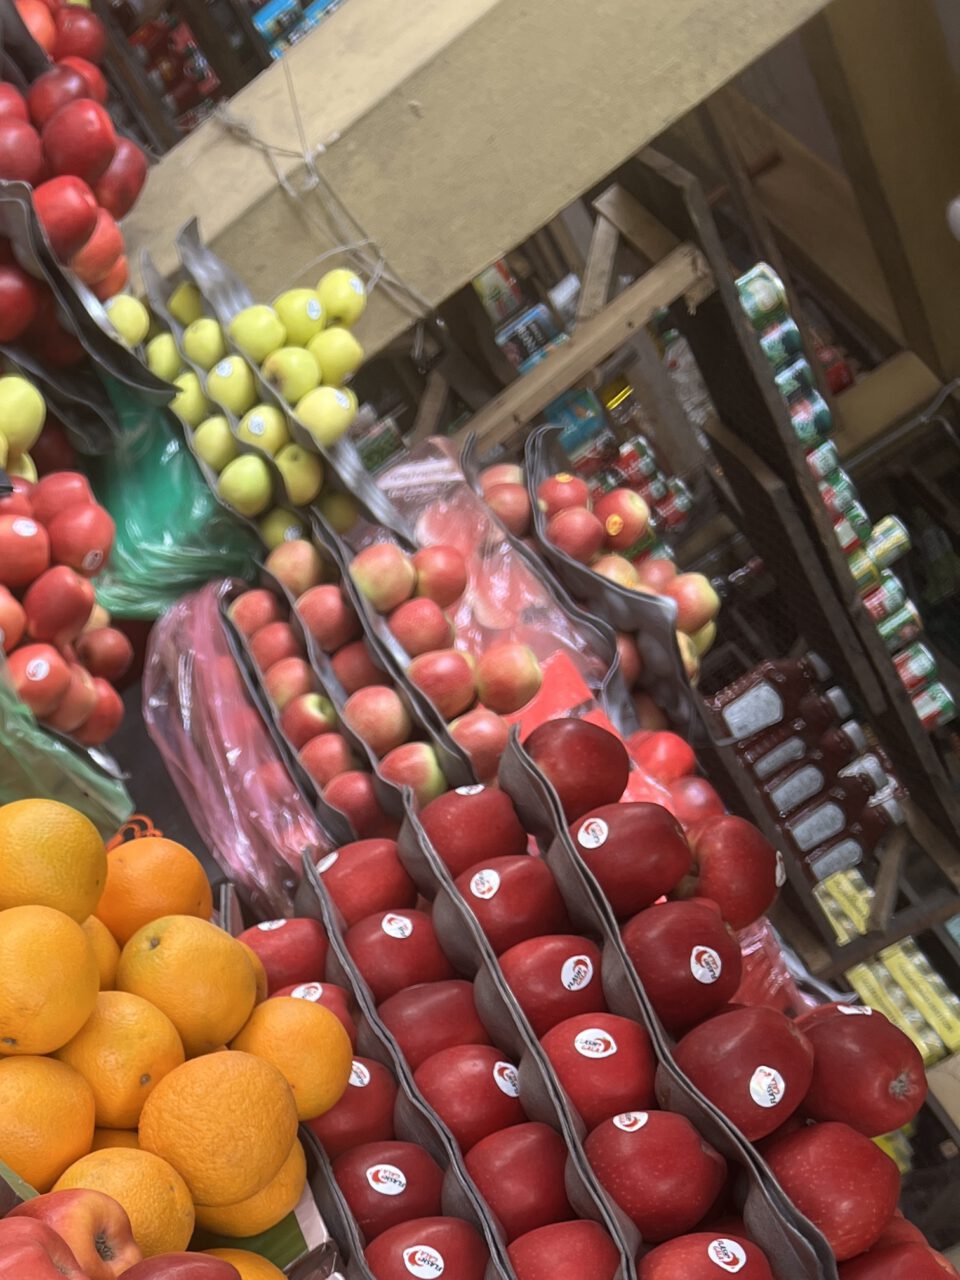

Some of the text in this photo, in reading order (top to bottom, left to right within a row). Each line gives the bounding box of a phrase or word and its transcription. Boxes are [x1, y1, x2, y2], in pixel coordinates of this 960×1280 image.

[567, 966, 582, 989] FLASH
[383, 1173, 406, 1188] FLASH
[418, 1256, 442, 1272] FLASH
